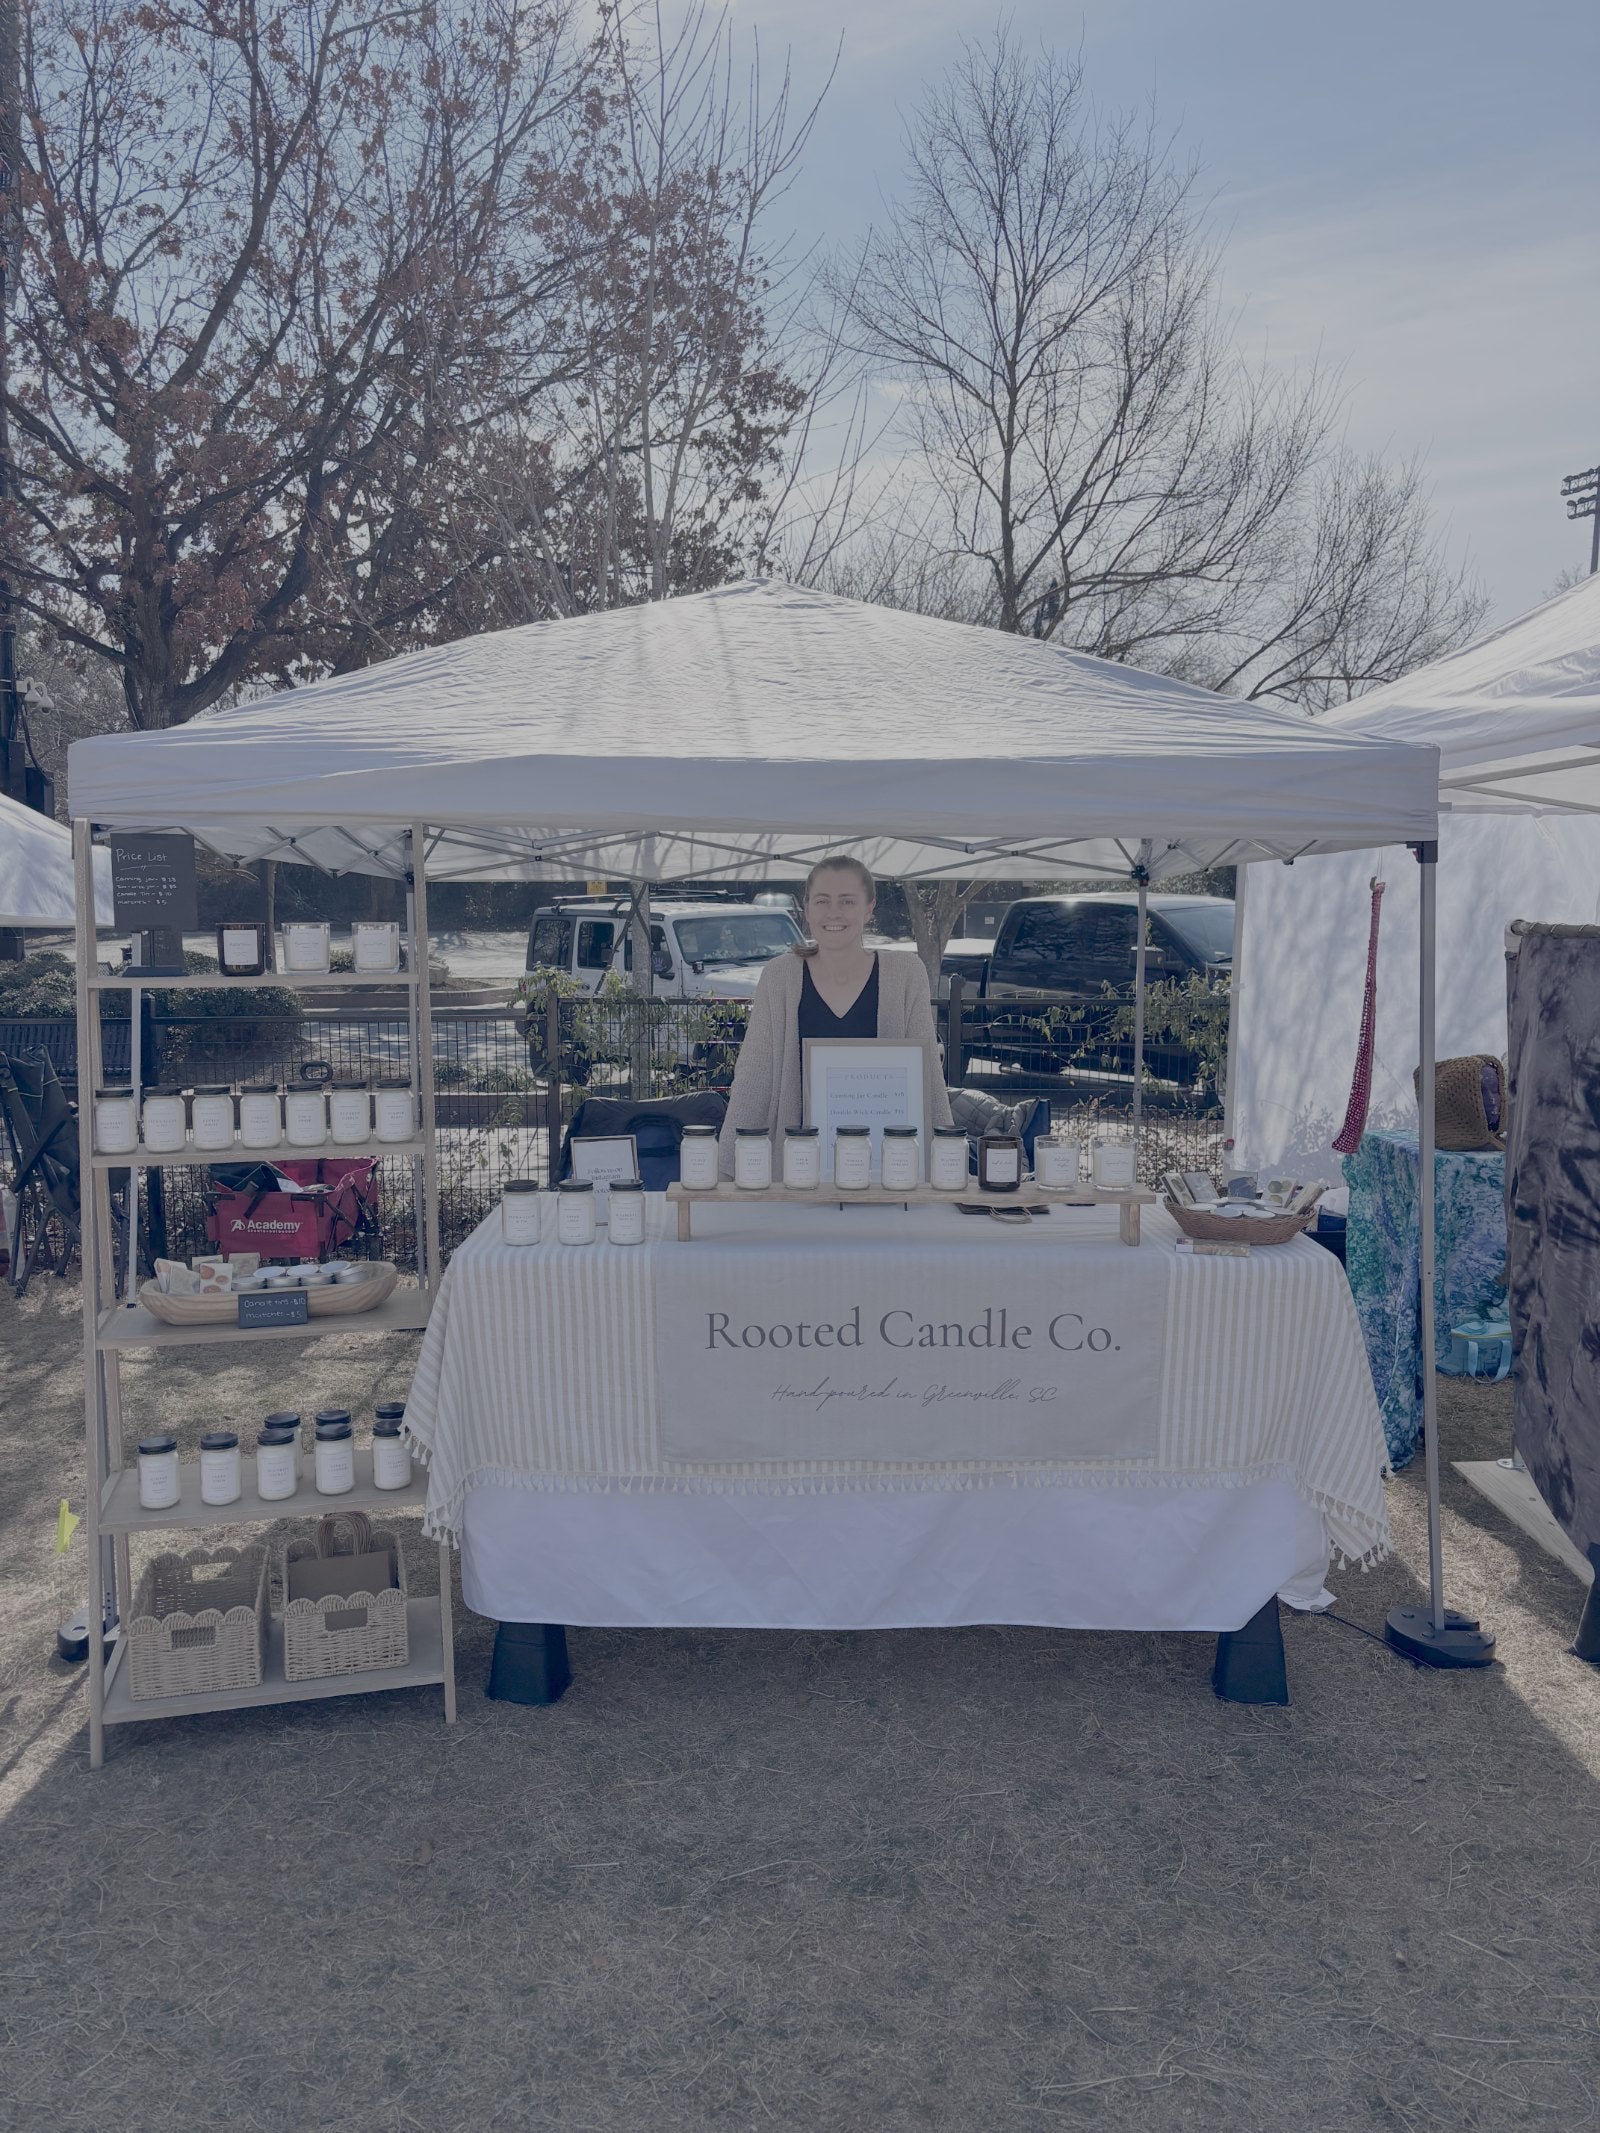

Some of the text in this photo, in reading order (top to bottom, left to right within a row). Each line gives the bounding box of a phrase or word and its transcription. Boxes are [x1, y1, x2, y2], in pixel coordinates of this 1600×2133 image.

[116, 848, 168, 863] Price List
[247, 1219, 302, 1232] Academy
[704, 1304, 1121, 1351] Rooted Candle Co.
[896, 1389, 919, 1399] in
[1028, 1386, 1058, 1404] SC
